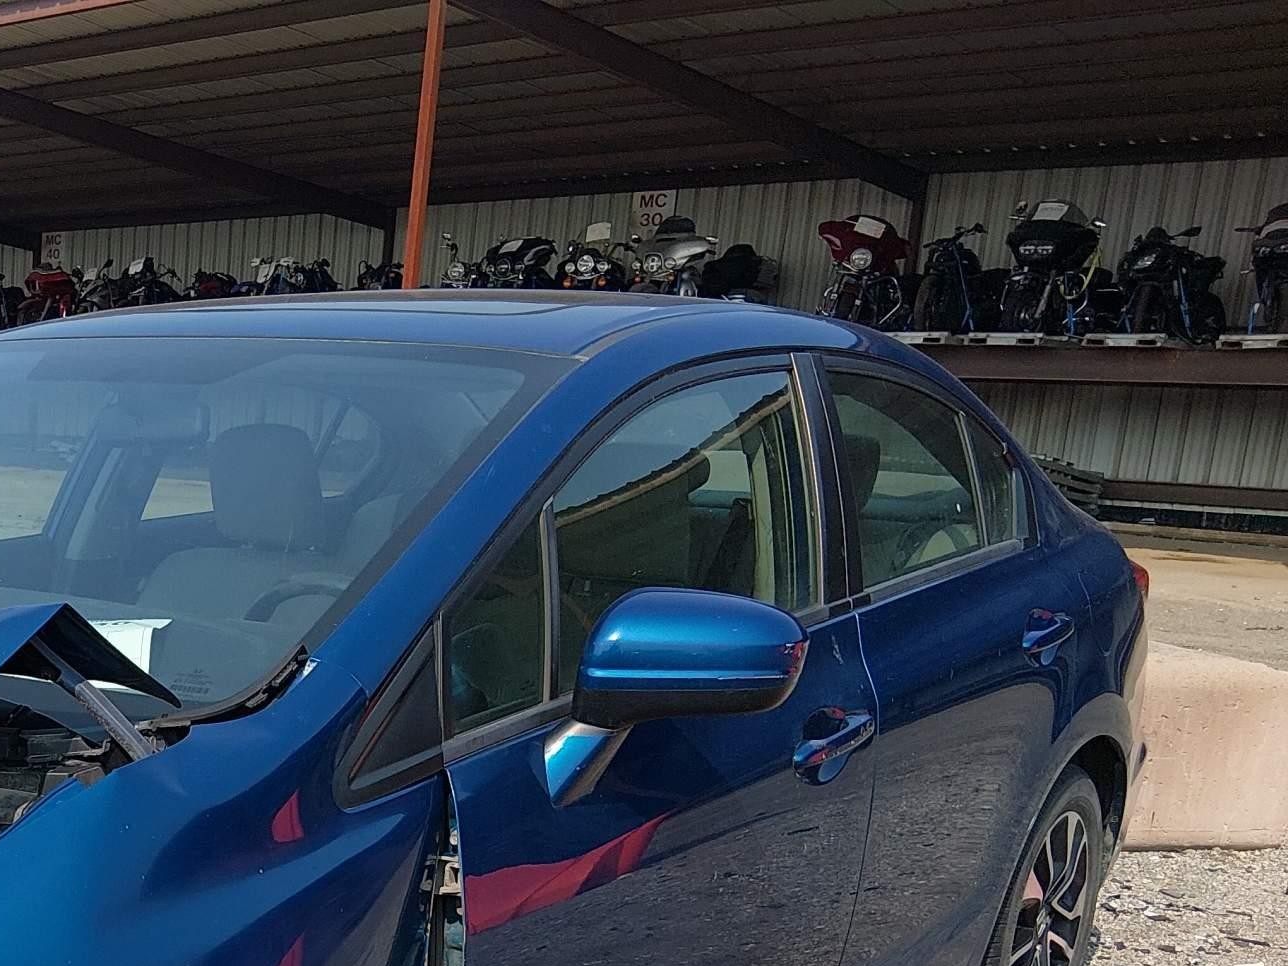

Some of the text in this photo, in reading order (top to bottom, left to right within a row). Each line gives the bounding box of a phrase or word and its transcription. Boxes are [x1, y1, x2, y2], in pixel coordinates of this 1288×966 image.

[639, 193, 667, 208] MC
[639, 212, 663, 226] 30
[45, 234, 61, 245] MC
[46, 248, 60, 259] 40
